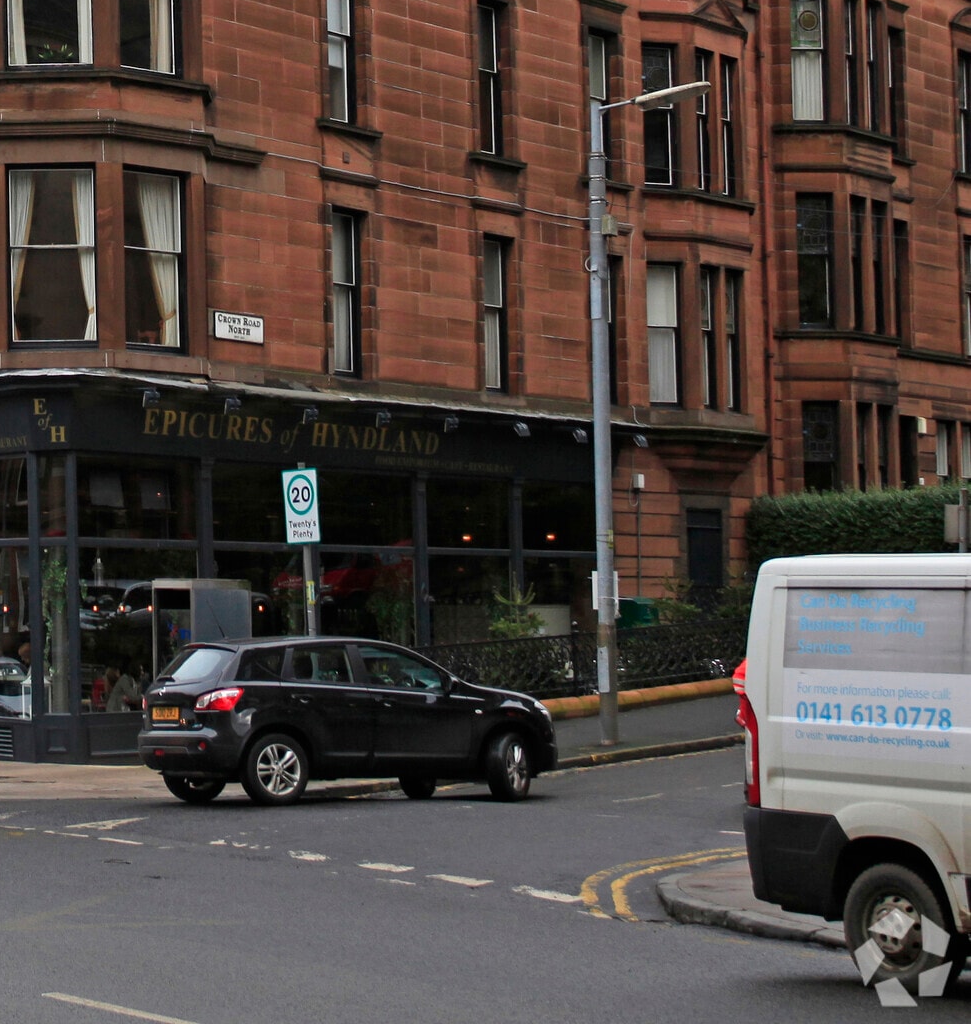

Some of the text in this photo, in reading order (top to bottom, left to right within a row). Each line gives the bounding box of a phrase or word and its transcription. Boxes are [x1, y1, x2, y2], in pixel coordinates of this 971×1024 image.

[218, 314, 261, 327] CROWN ROAD
[229, 325, 251, 336] NORTH
[33, 398, 47, 415] E
[38, 413, 53, 431] of
[50, 426, 66, 443] H
[142, 408, 439, 455] EPICURES of HYNDLAND
[291, 486, 310, 503] 20
[289, 519, 316, 529] Twenty's
[293, 529, 313, 538] Plenty
[800, 593, 916, 613] Can Do Recycling
[799, 615, 926, 638] Business Recycling
[797, 639, 852, 655] Services
[796, 682, 951, 701] For more information please call:
[796, 701, 953, 731] 0141 613 0778
[825, 732, 950, 749] www.can-do-recycling.co.uk
